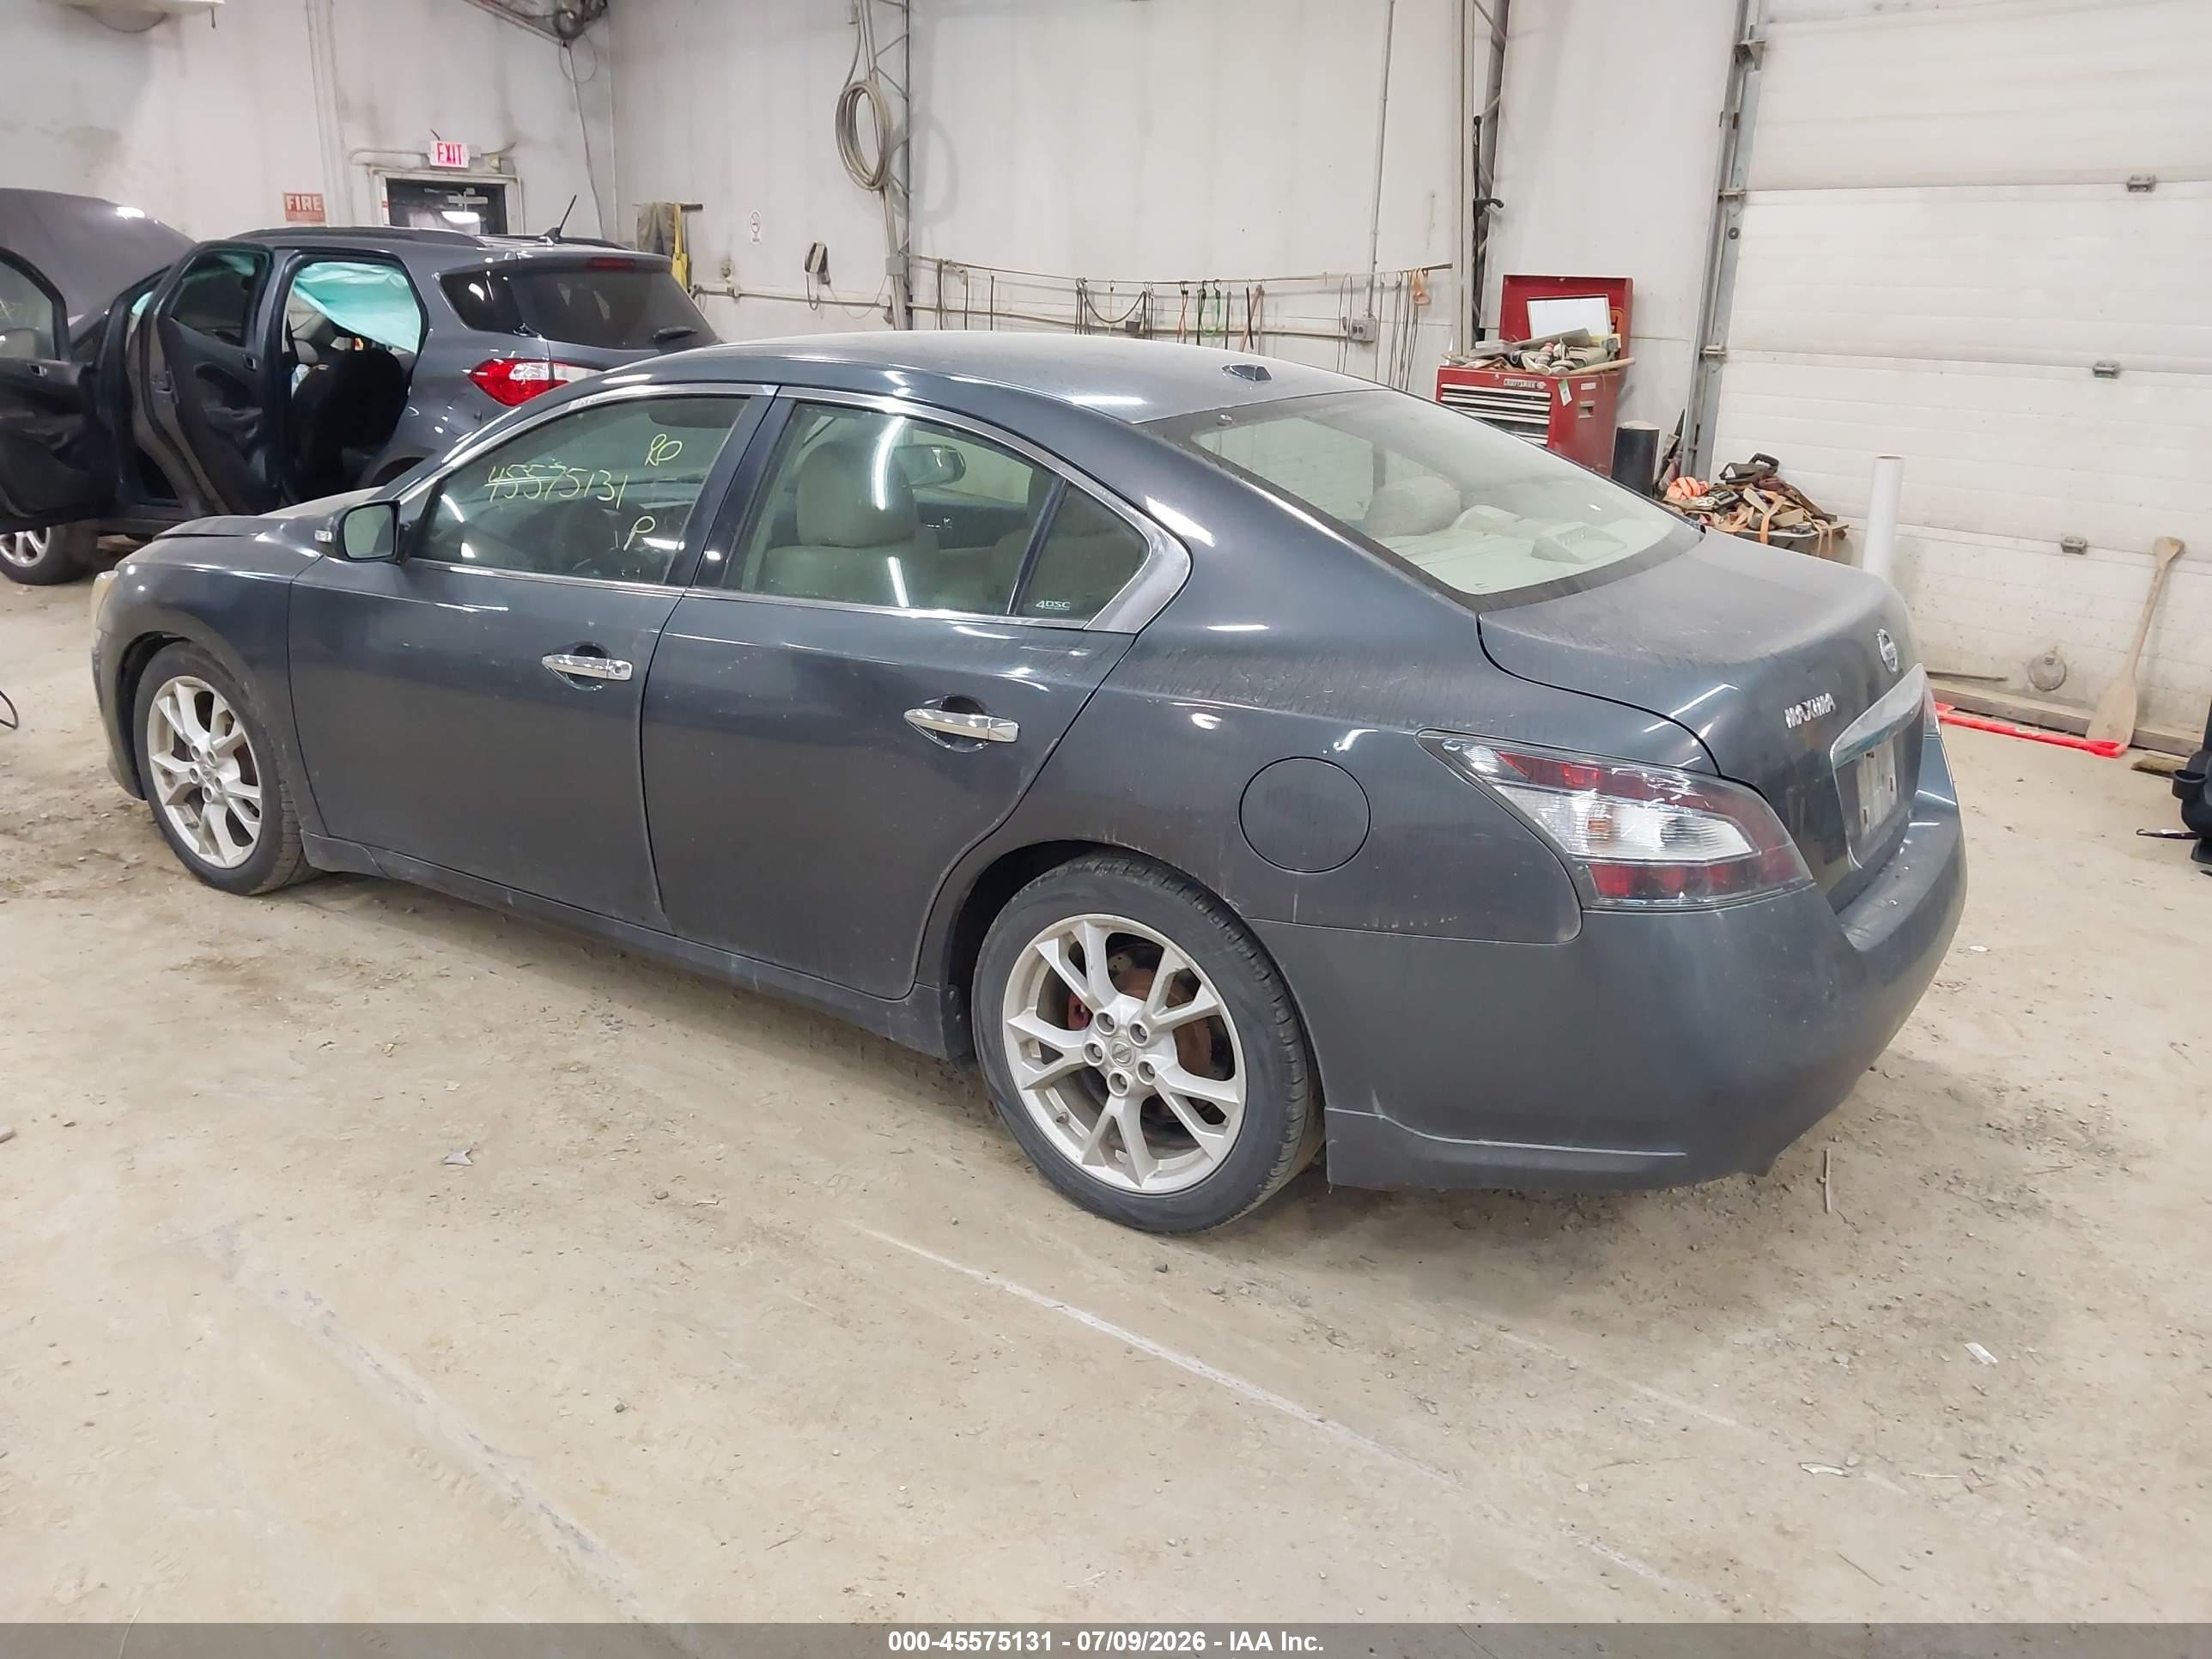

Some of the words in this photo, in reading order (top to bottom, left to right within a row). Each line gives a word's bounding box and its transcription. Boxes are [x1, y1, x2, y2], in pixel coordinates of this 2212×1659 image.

[437, 143, 462, 165] EXIT
[285, 195, 323, 211] FIRE
[484, 465, 629, 509] 45575131
[1784, 692, 1837, 729] MAXIMA
